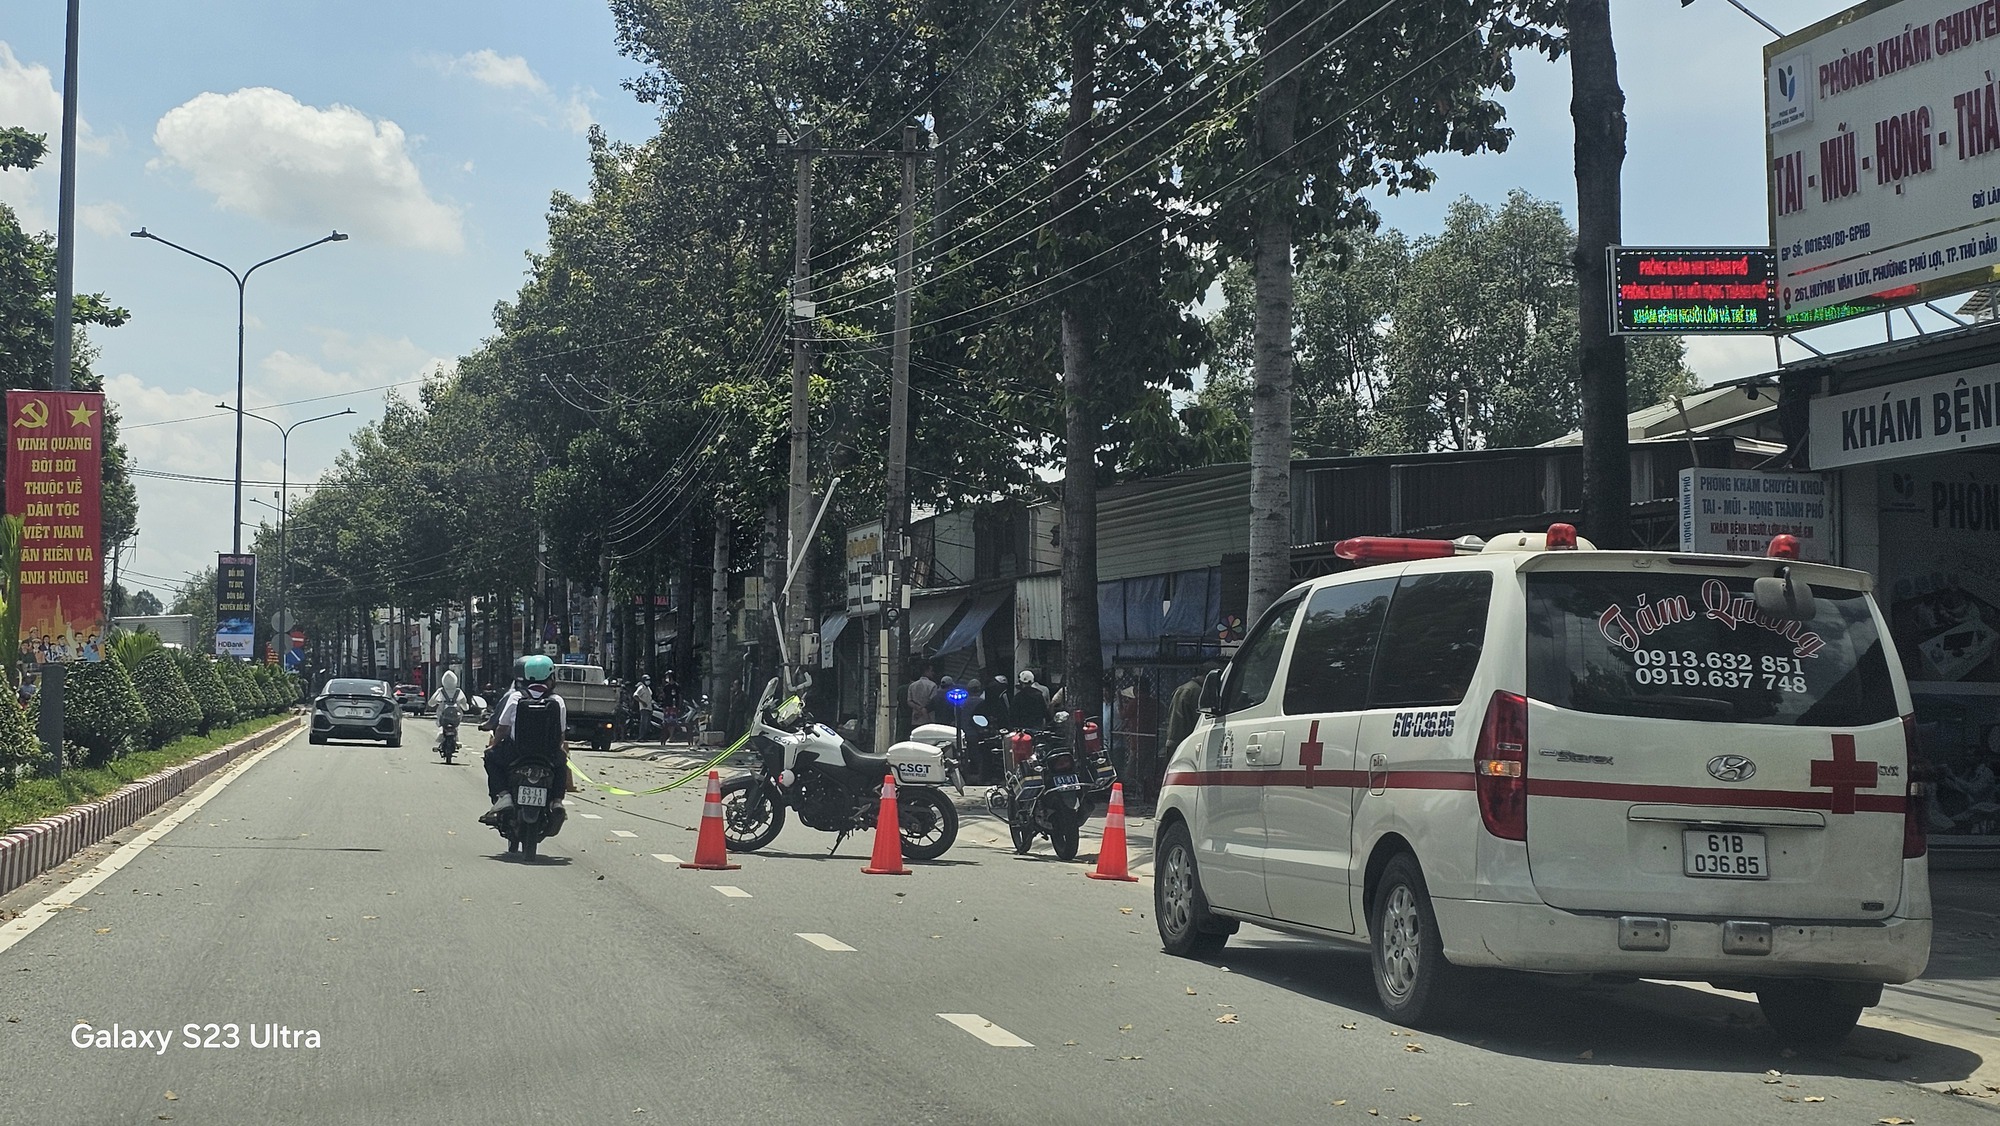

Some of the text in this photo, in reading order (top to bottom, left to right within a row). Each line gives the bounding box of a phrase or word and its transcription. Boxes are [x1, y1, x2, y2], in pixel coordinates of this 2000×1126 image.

[1819, 48, 1875, 100] PHÒNG
[1877, 23, 1932, 77] KHÁM
[1774, 150, 1803, 216] TAI
[1820, 122, 1858, 203] MŨI
[1875, 106, 1932, 195] HỌNG
[1953, 70, 2000, 160] THÀ
[1781, 247, 1792, 261] GP
[1979, 232, 1998, 256] DẦU
[1842, 392, 1922, 451] KHÁM
[17, 437, 92, 452] VINH QUANG
[31, 456, 77, 473] ĐỜI ĐỜI
[24, 476, 83, 497] THUỘC VỀ
[1801, 480, 1825, 495] KHOA
[27, 500, 79, 519] DÂN TỘC
[1702, 499, 1716, 514] TAI
[1749, 500, 1773, 519] HỌNG
[1775, 498, 1804, 518] THÀNH
[1806, 498, 1824, 519] PHỐ
[22, 523, 84, 541] VIỆT NAM
[20, 543, 93, 562] ĂN HIẾN VÀ
[20, 568, 89, 585] ANH HÙNG!
[1598, 593, 1696, 652] Tám
[1633, 649, 1805, 675] 0913.632 851
[1635, 667, 1808, 693] 0919.637 748
[1708, 834, 1744, 853] 61B
[1695, 854, 1759, 874] 036.85
